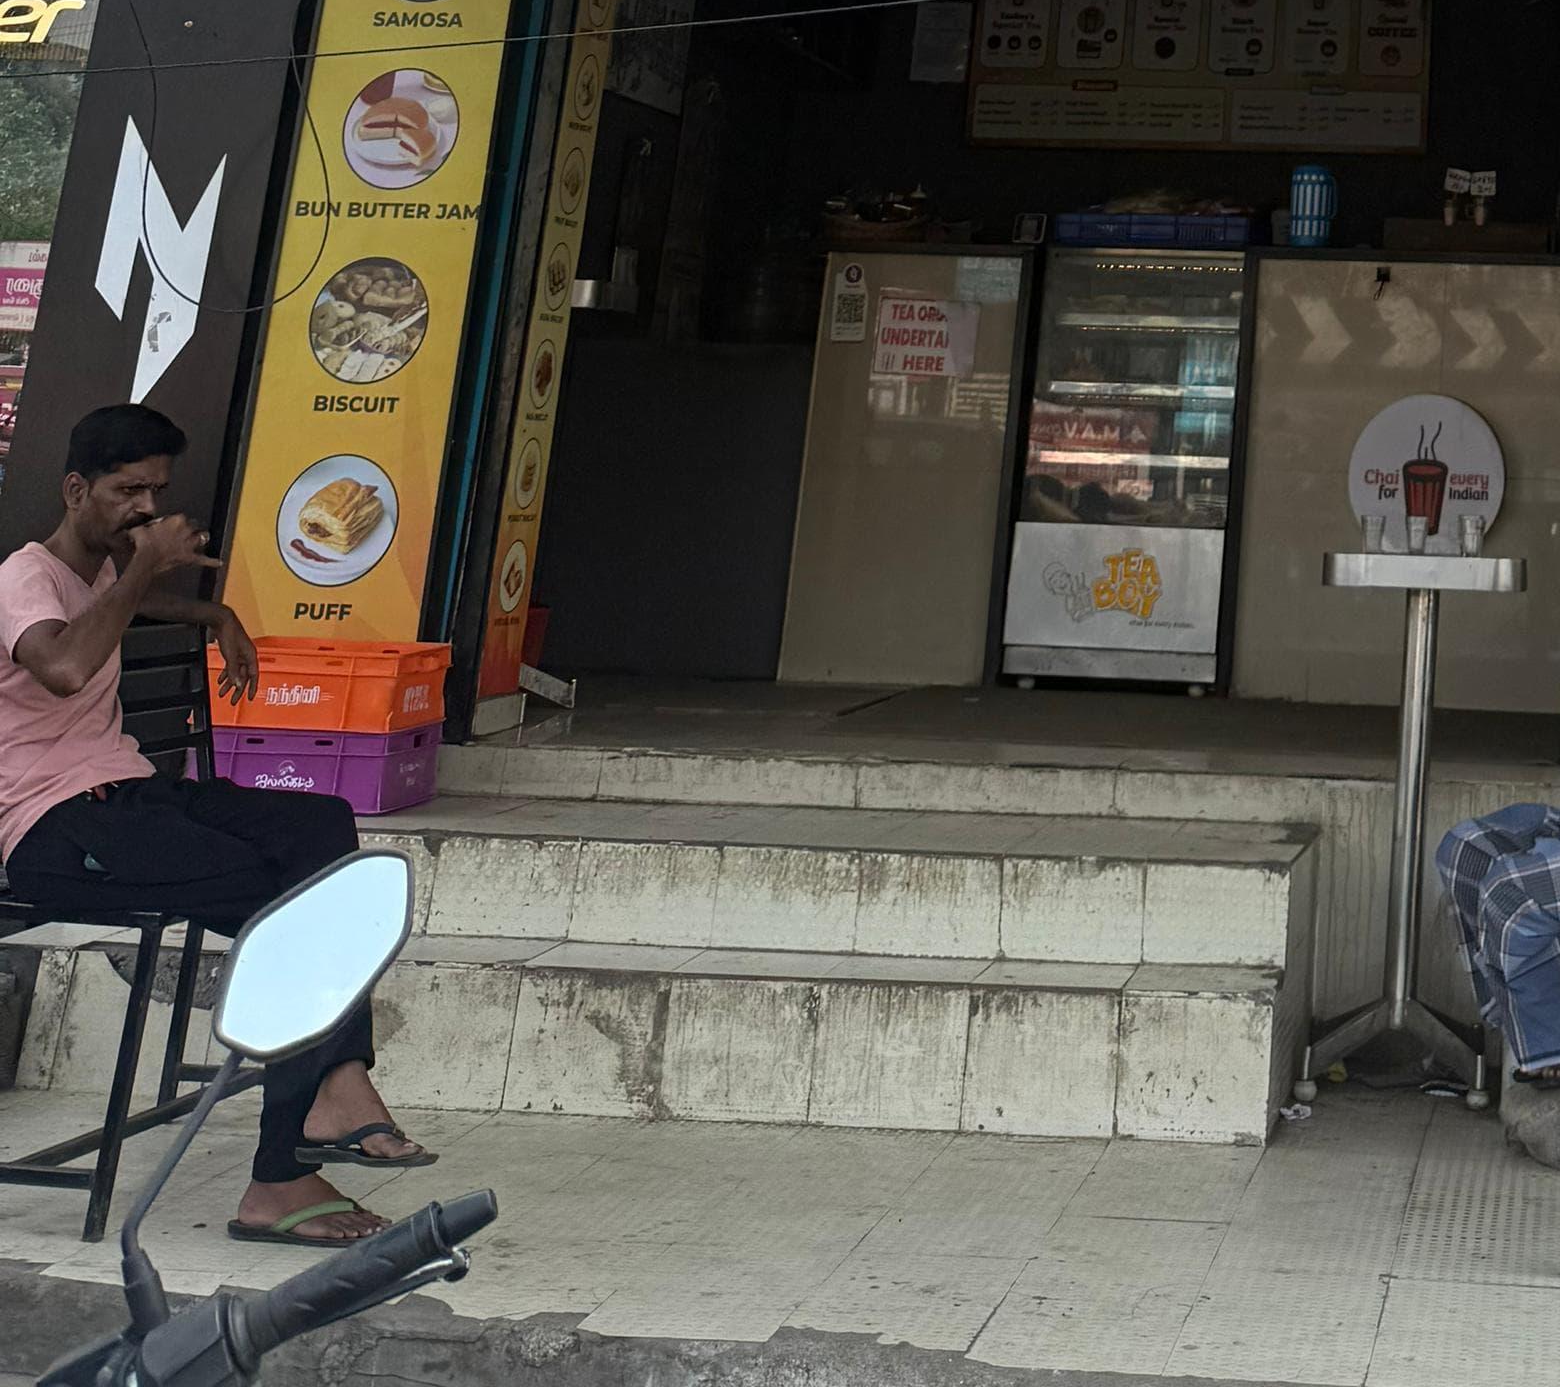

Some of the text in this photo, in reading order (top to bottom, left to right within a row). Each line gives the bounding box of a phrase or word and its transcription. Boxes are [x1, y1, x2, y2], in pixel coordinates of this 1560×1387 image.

[373, 12, 463, 27] SAMOSA
[295, 200, 481, 221] BUN BUTTER JAM
[903, 355, 944, 371] HERE
[313, 395, 400, 415] BISCUIT
[1365, 469, 1399, 485] Chai
[1378, 485, 1488, 500] for Indian
[294, 603, 352, 621] PUFF
